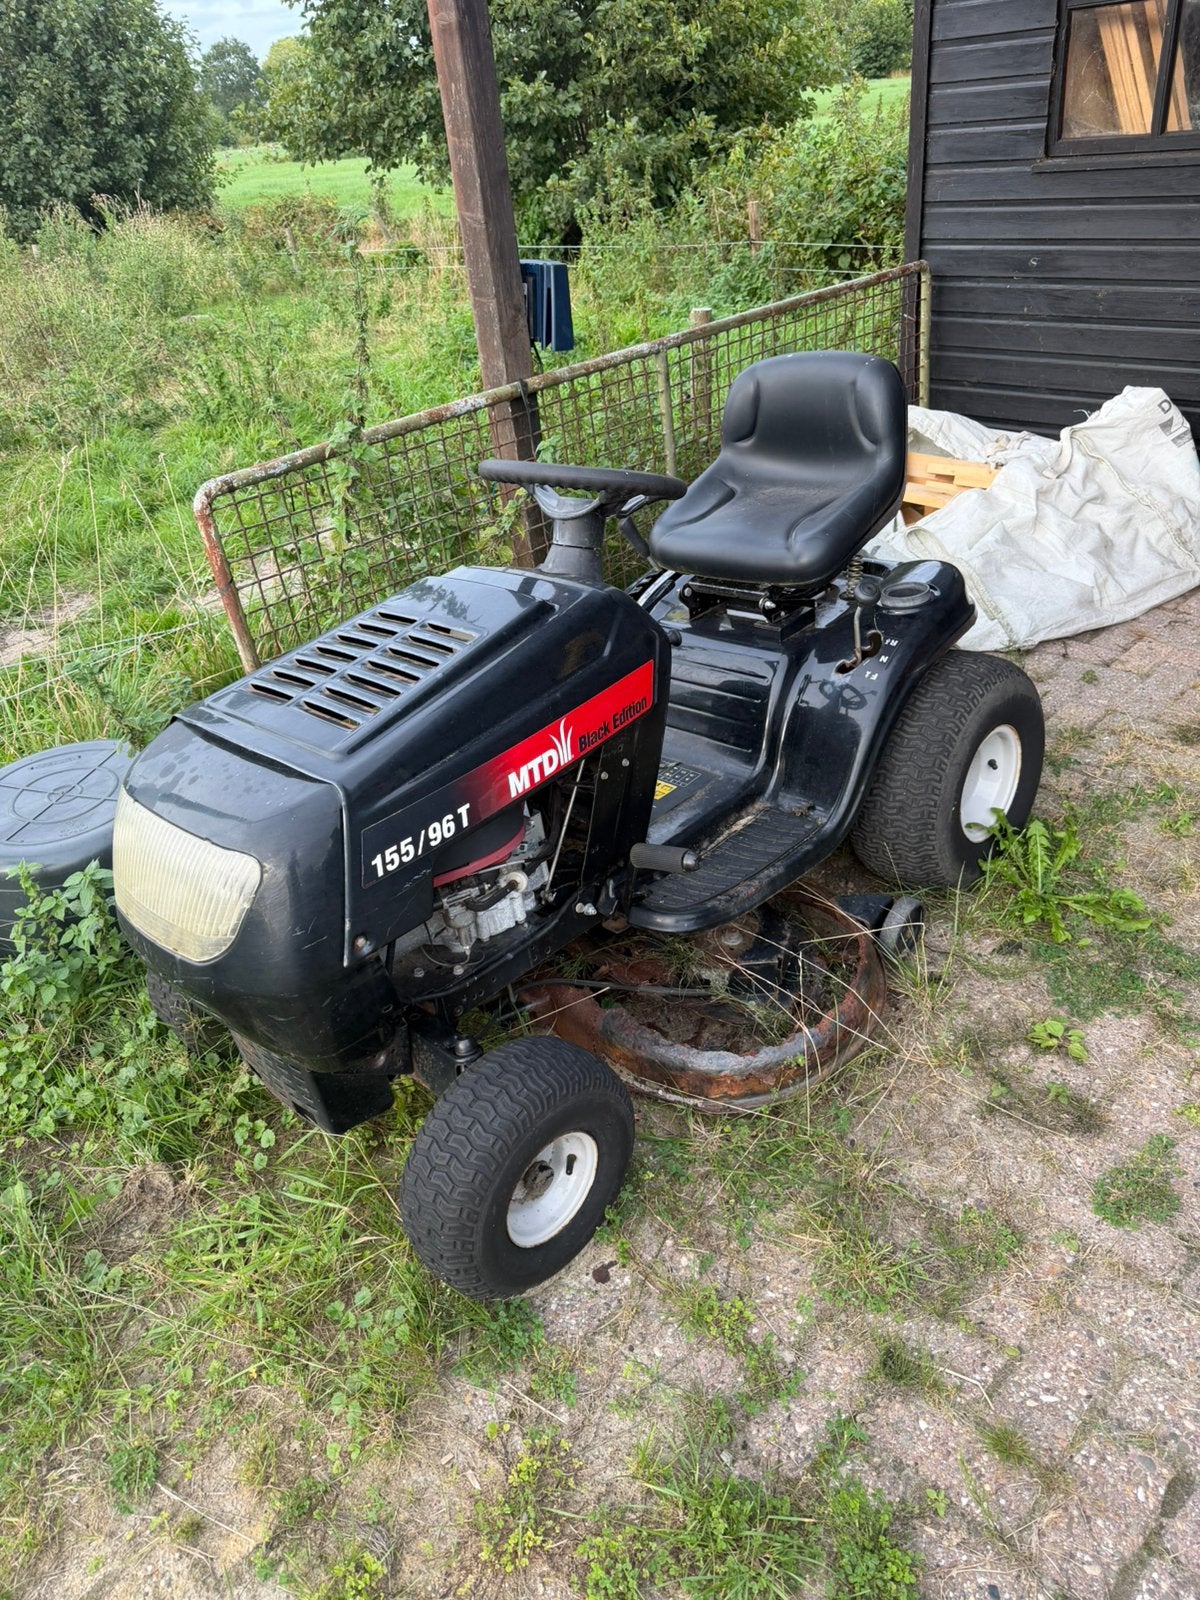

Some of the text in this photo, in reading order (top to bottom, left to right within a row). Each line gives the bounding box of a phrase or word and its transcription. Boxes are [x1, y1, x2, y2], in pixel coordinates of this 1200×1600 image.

[879, 655, 889, 663] N
[578, 697, 647, 753] Black Edition
[507, 748, 559, 798] MTD
[371, 802, 471, 878] 155/96 T
